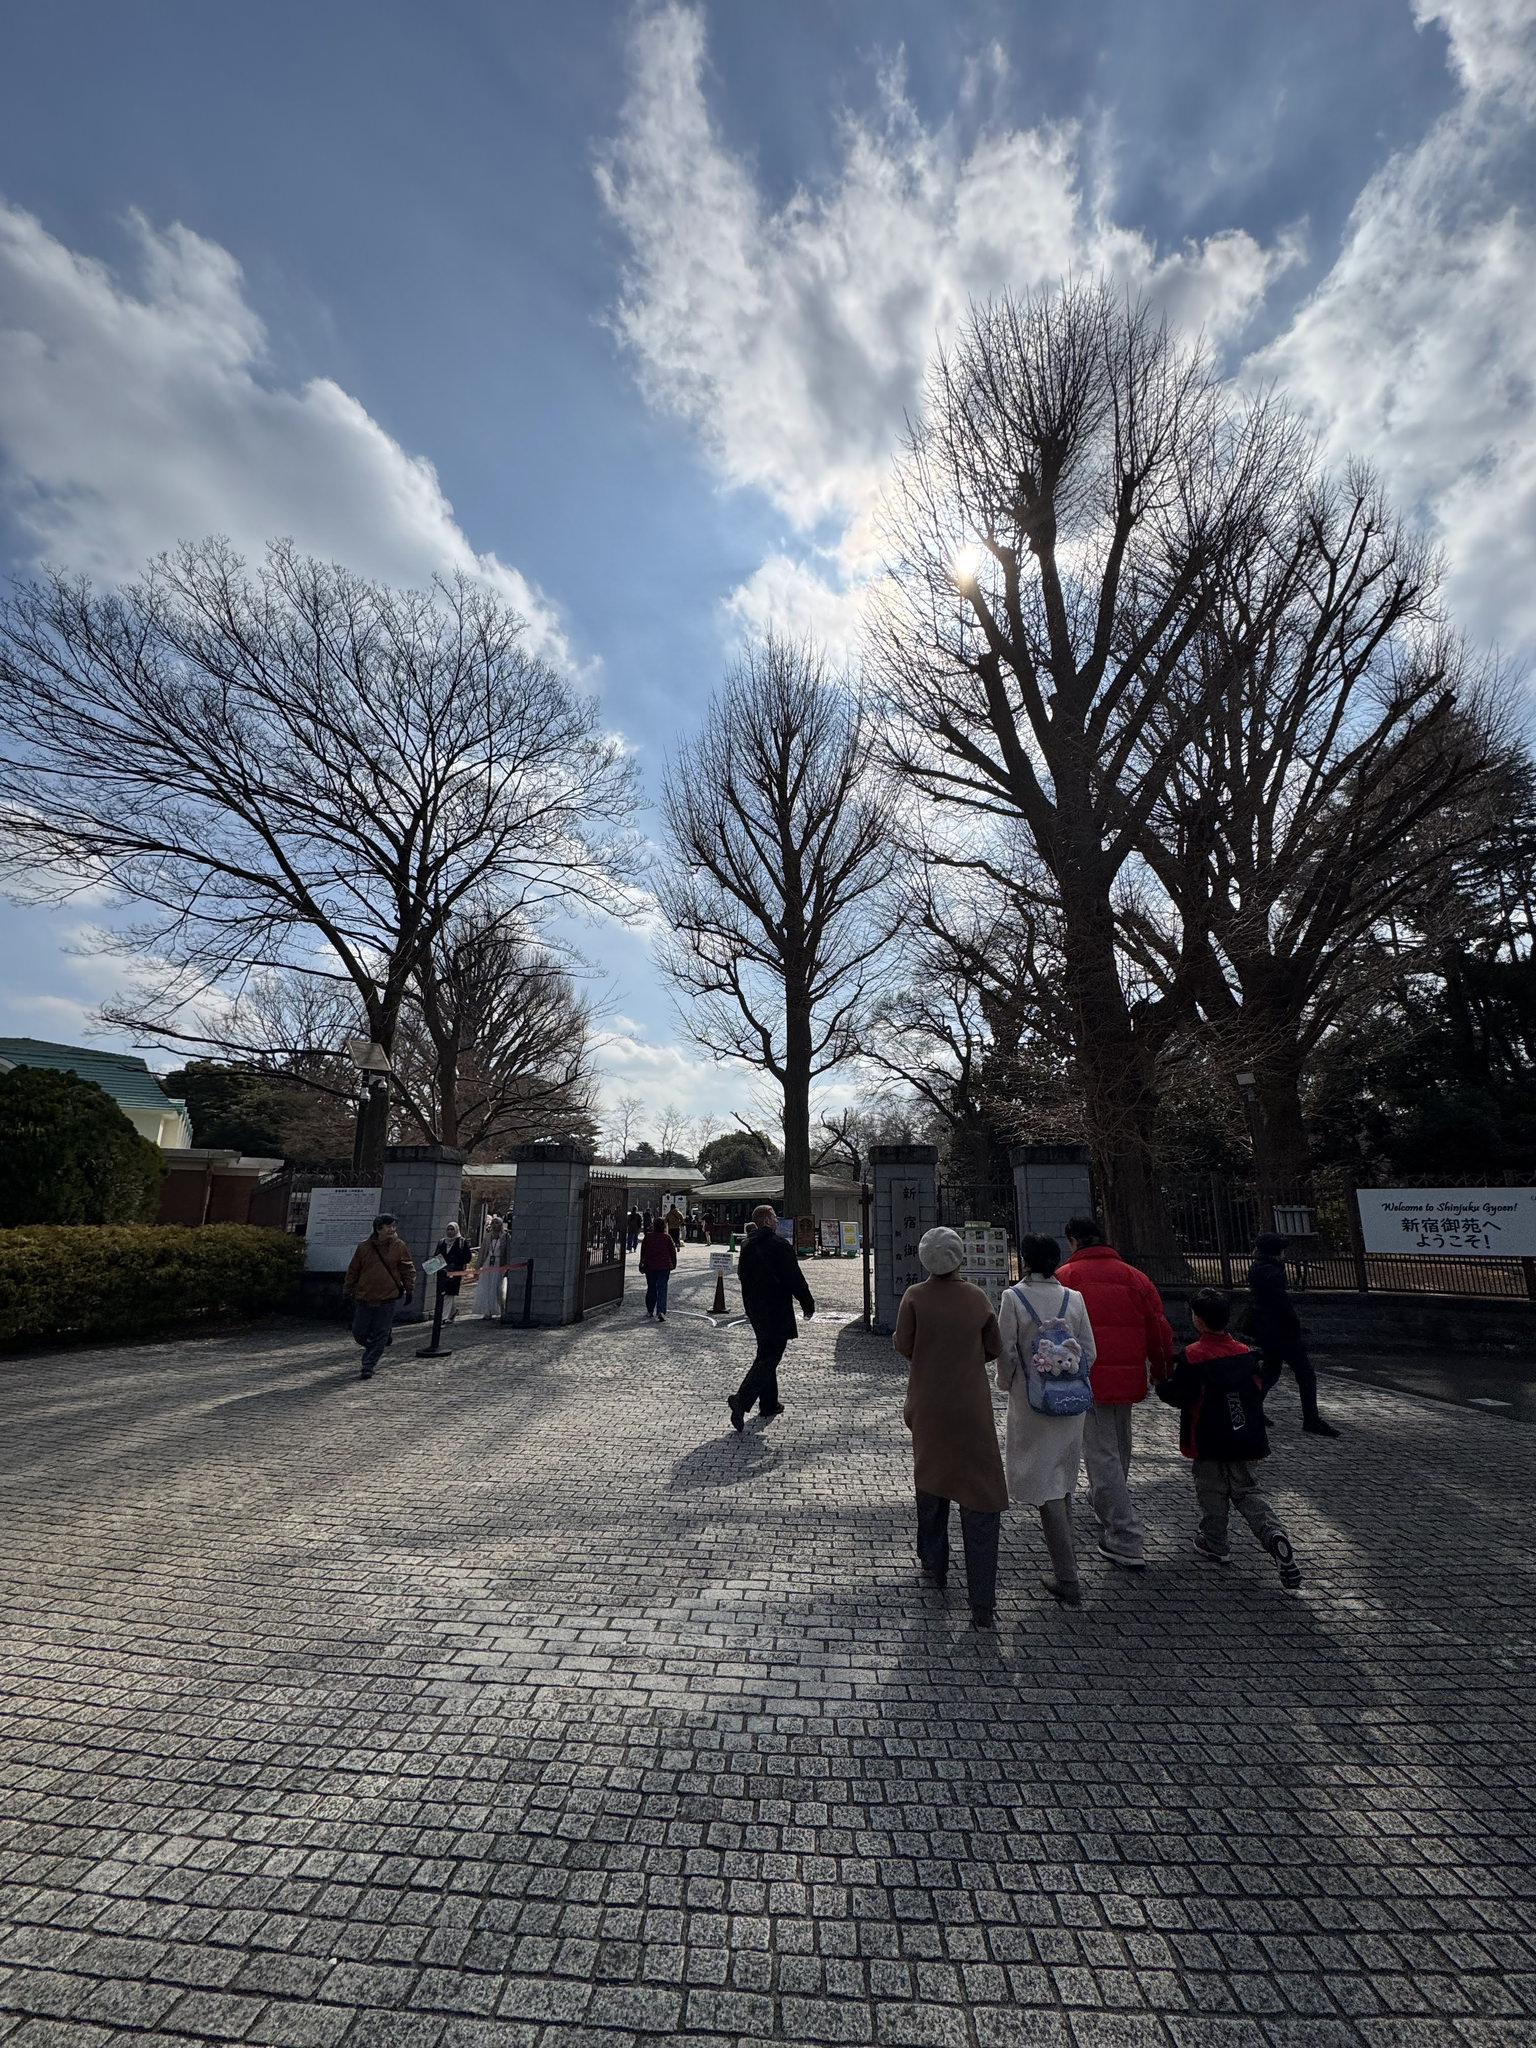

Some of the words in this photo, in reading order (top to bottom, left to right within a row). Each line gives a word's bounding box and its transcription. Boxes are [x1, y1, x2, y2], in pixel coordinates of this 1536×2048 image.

[1381, 1202, 1423, 1212] Welcome
[1425, 1203, 1434, 1212] to
[1436, 1201, 1480, 1216] Shinjuku
[1482, 1202, 1518, 1216] Gyoen!
[1401, 1217, 1502, 1234] 新宿御苑へ
[903, 1186, 918, 1287] 新宿御苑
[1416, 1234, 1491, 1249] ようこそ!
